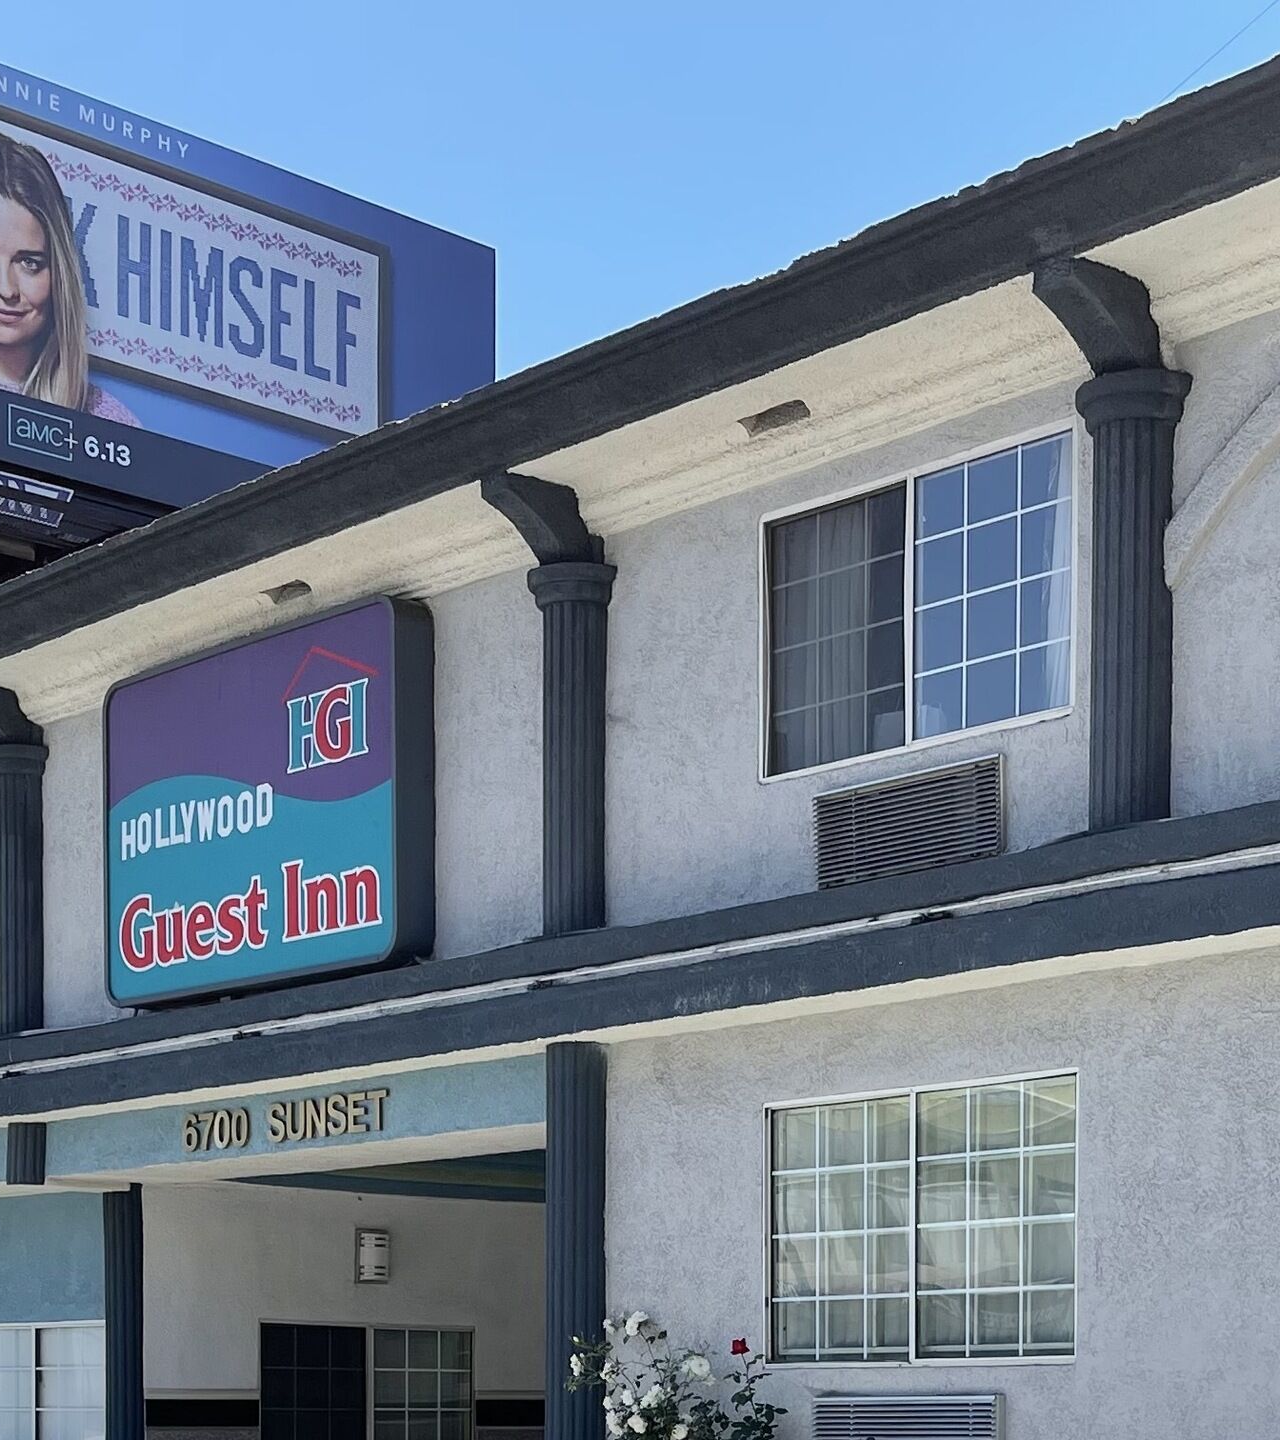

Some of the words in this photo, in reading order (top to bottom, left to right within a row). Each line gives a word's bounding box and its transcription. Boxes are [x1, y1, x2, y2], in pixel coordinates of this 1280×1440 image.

[78, 105, 192, 160] MURPHY
[117, 213, 361, 387] HIMSELF
[83, 436, 132, 467] 6.13
[286, 677, 369, 774] HGI
[120, 782, 273, 861] HOLLYWOOD
[119, 874, 270, 973] Guest
[280, 859, 382, 945] Inn
[182, 1106, 251, 1154] 6700
[267, 1088, 392, 1144] SUNSET
